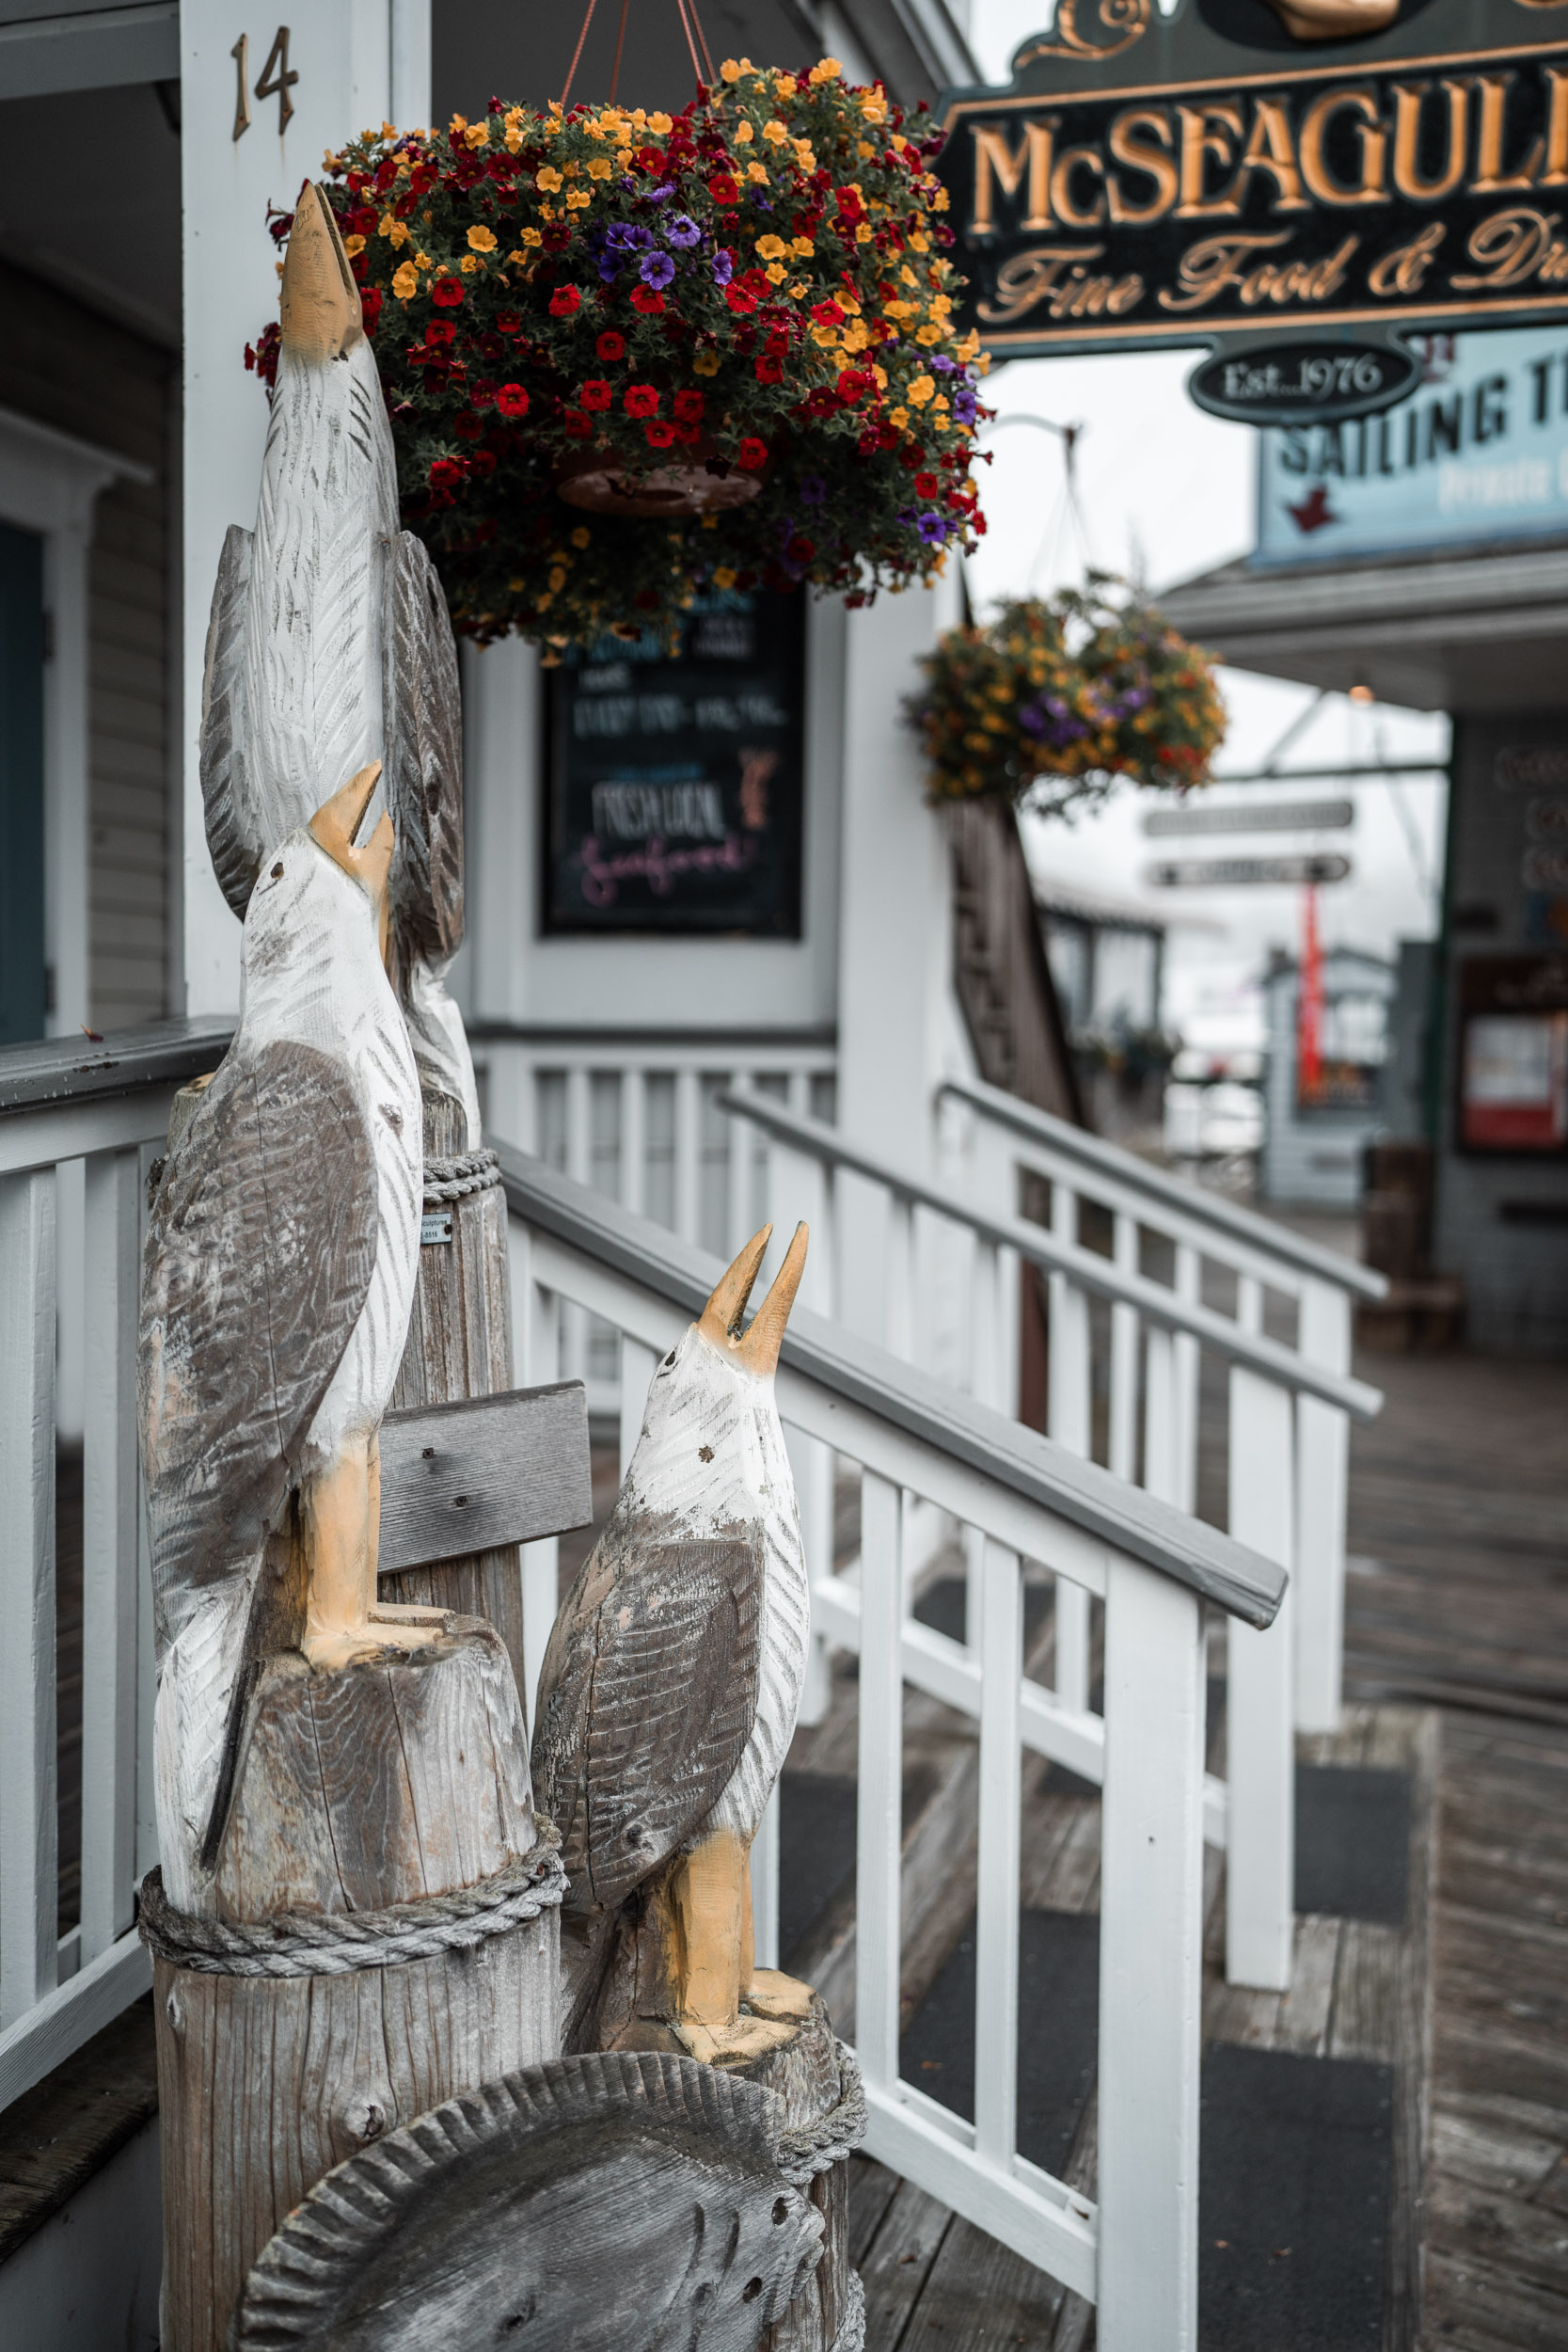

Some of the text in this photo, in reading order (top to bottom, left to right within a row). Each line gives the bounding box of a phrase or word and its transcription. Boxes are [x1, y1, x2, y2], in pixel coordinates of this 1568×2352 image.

[230, 25, 299, 142] 14
[976, 243, 1145, 323] Fine
[1158, 229, 1360, 311] Food
[1368, 221, 1447, 295] &
[1299, 352, 1384, 402] 1976
